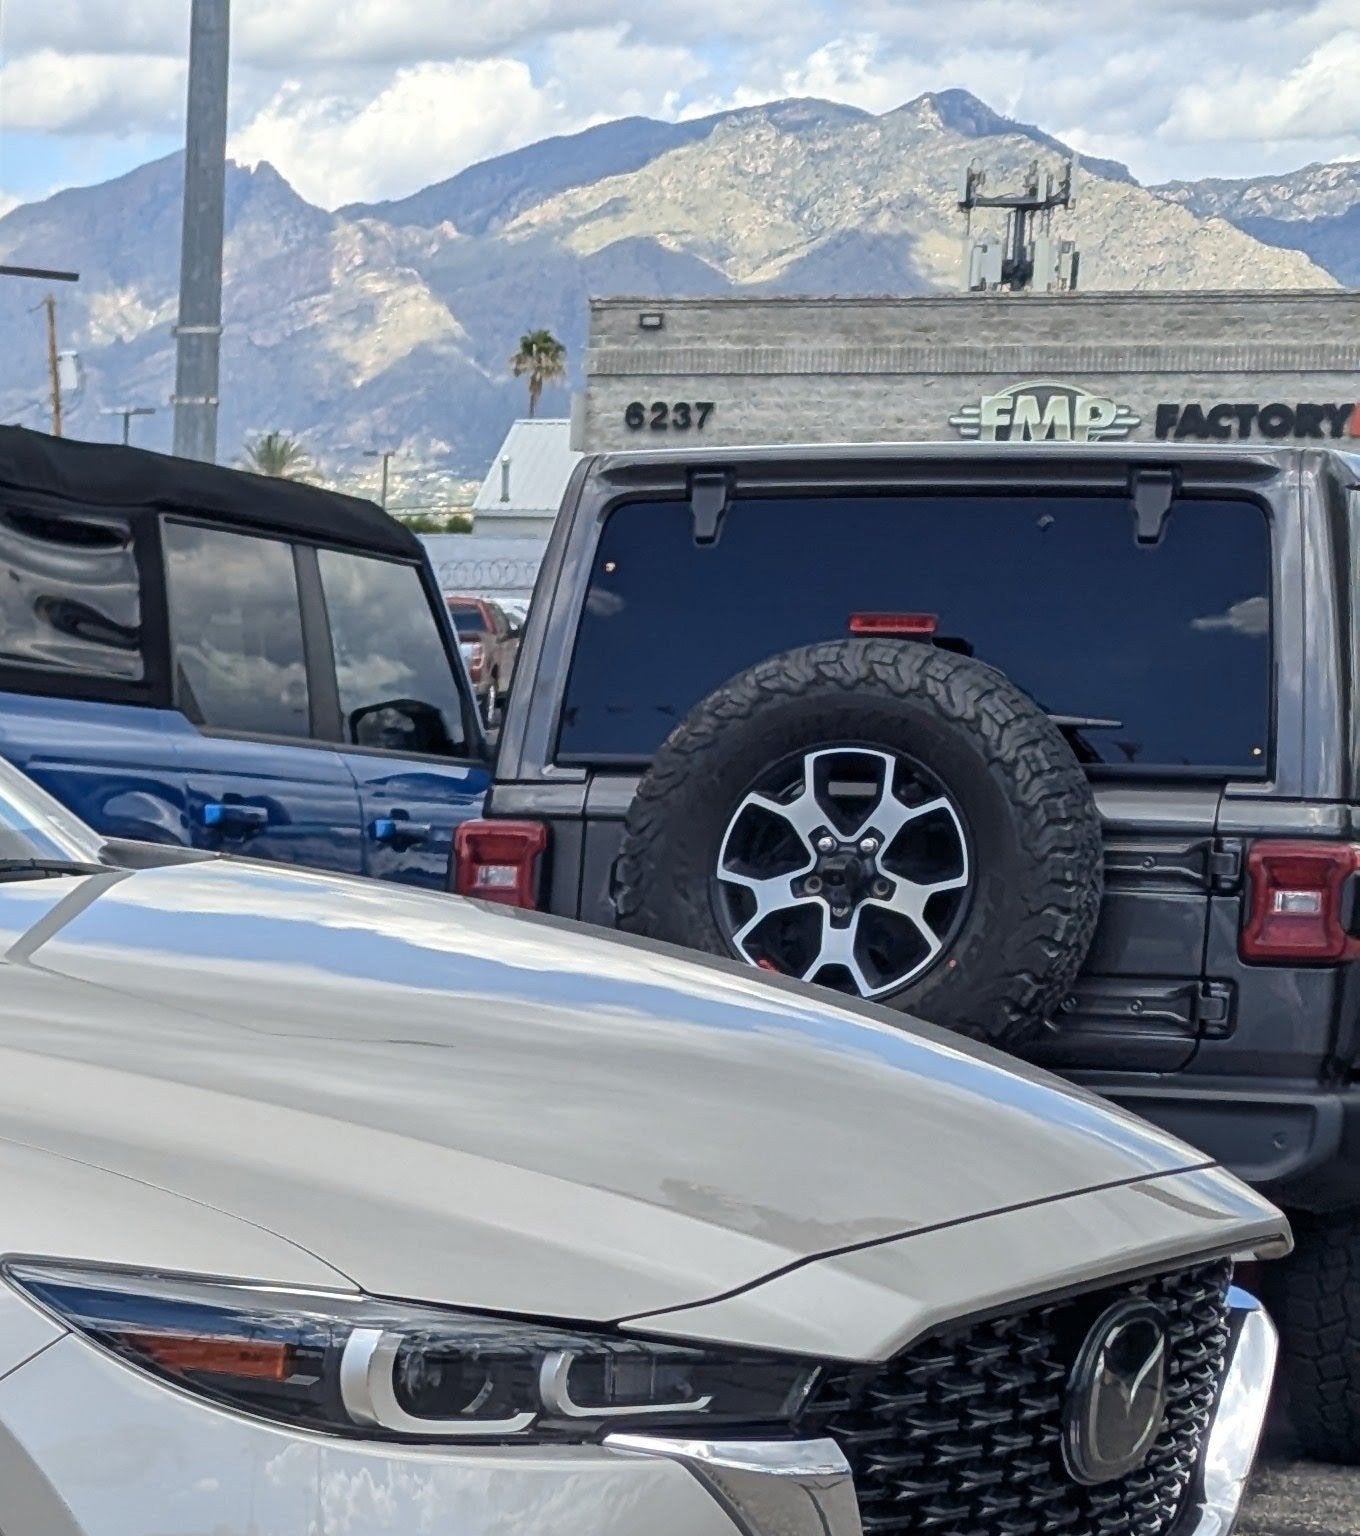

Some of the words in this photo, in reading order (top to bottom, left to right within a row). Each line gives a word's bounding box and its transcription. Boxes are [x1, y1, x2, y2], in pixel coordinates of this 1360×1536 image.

[625, 401, 715, 430] 6237
[979, 395, 1120, 442] FMP
[1156, 403, 1354, 439] FACTORY
